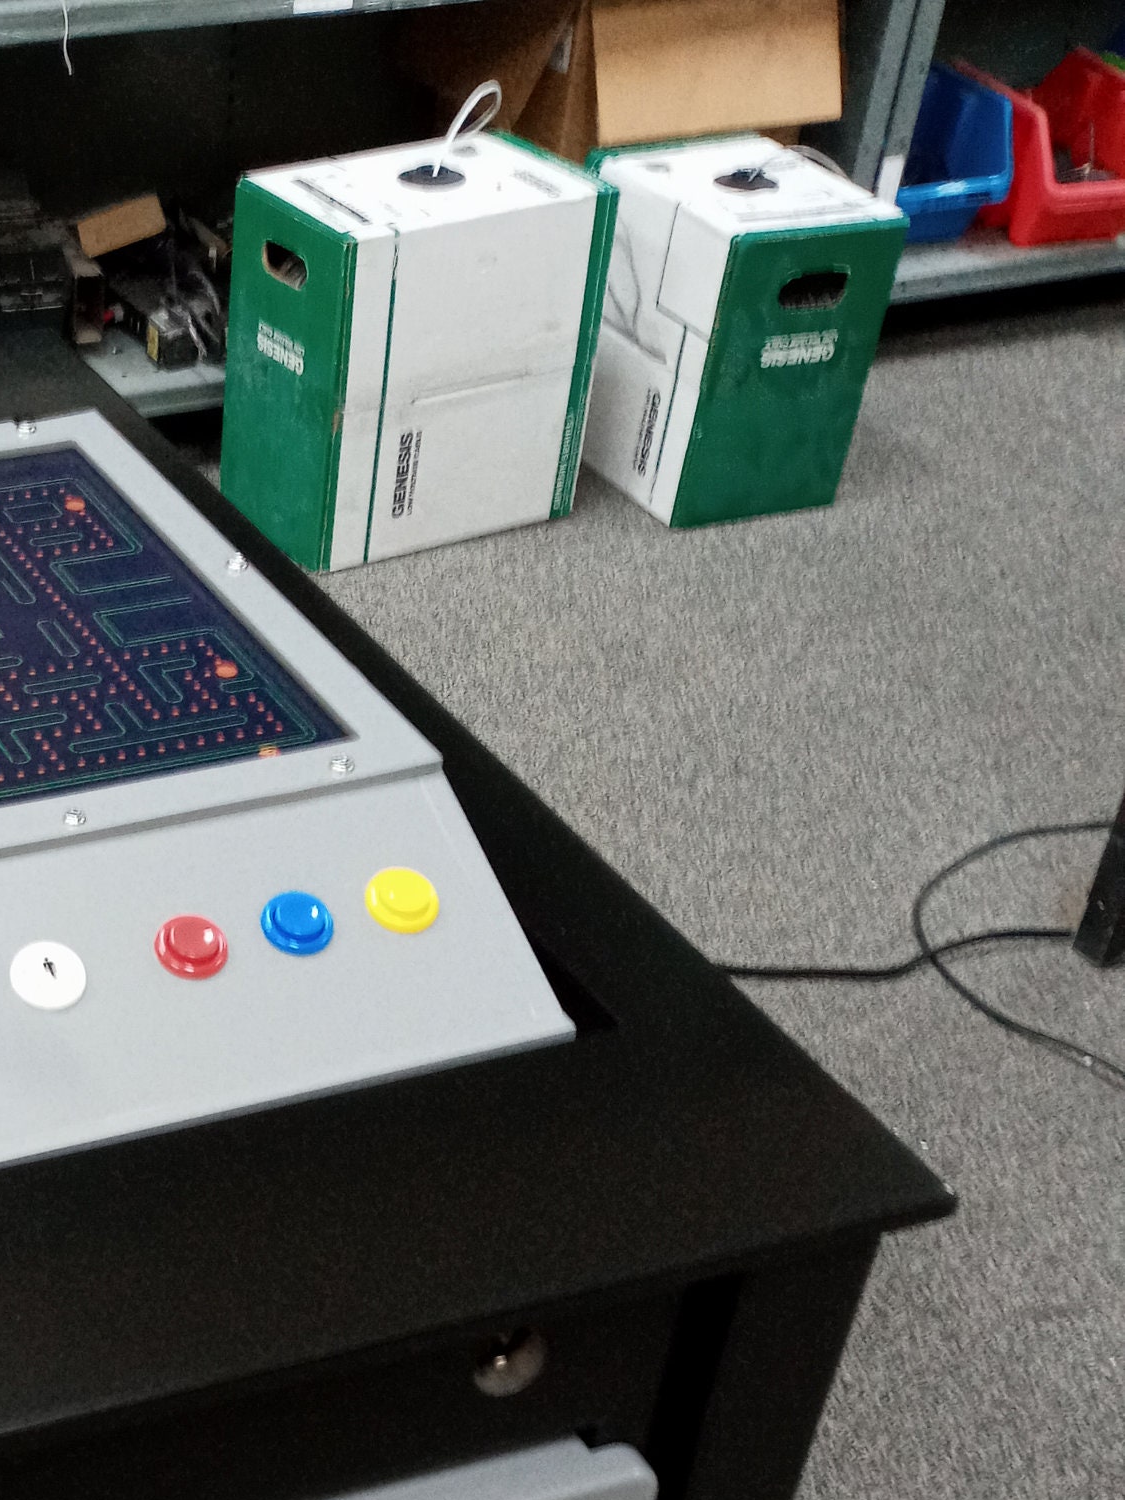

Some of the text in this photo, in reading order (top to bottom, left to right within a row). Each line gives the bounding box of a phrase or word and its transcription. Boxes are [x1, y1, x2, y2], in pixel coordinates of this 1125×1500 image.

[257, 333, 304, 376] GENESIS
[761, 343, 836, 369] GENESIS
[638, 392, 661, 477] GENESIS
[391, 432, 414, 519] GENESIS
